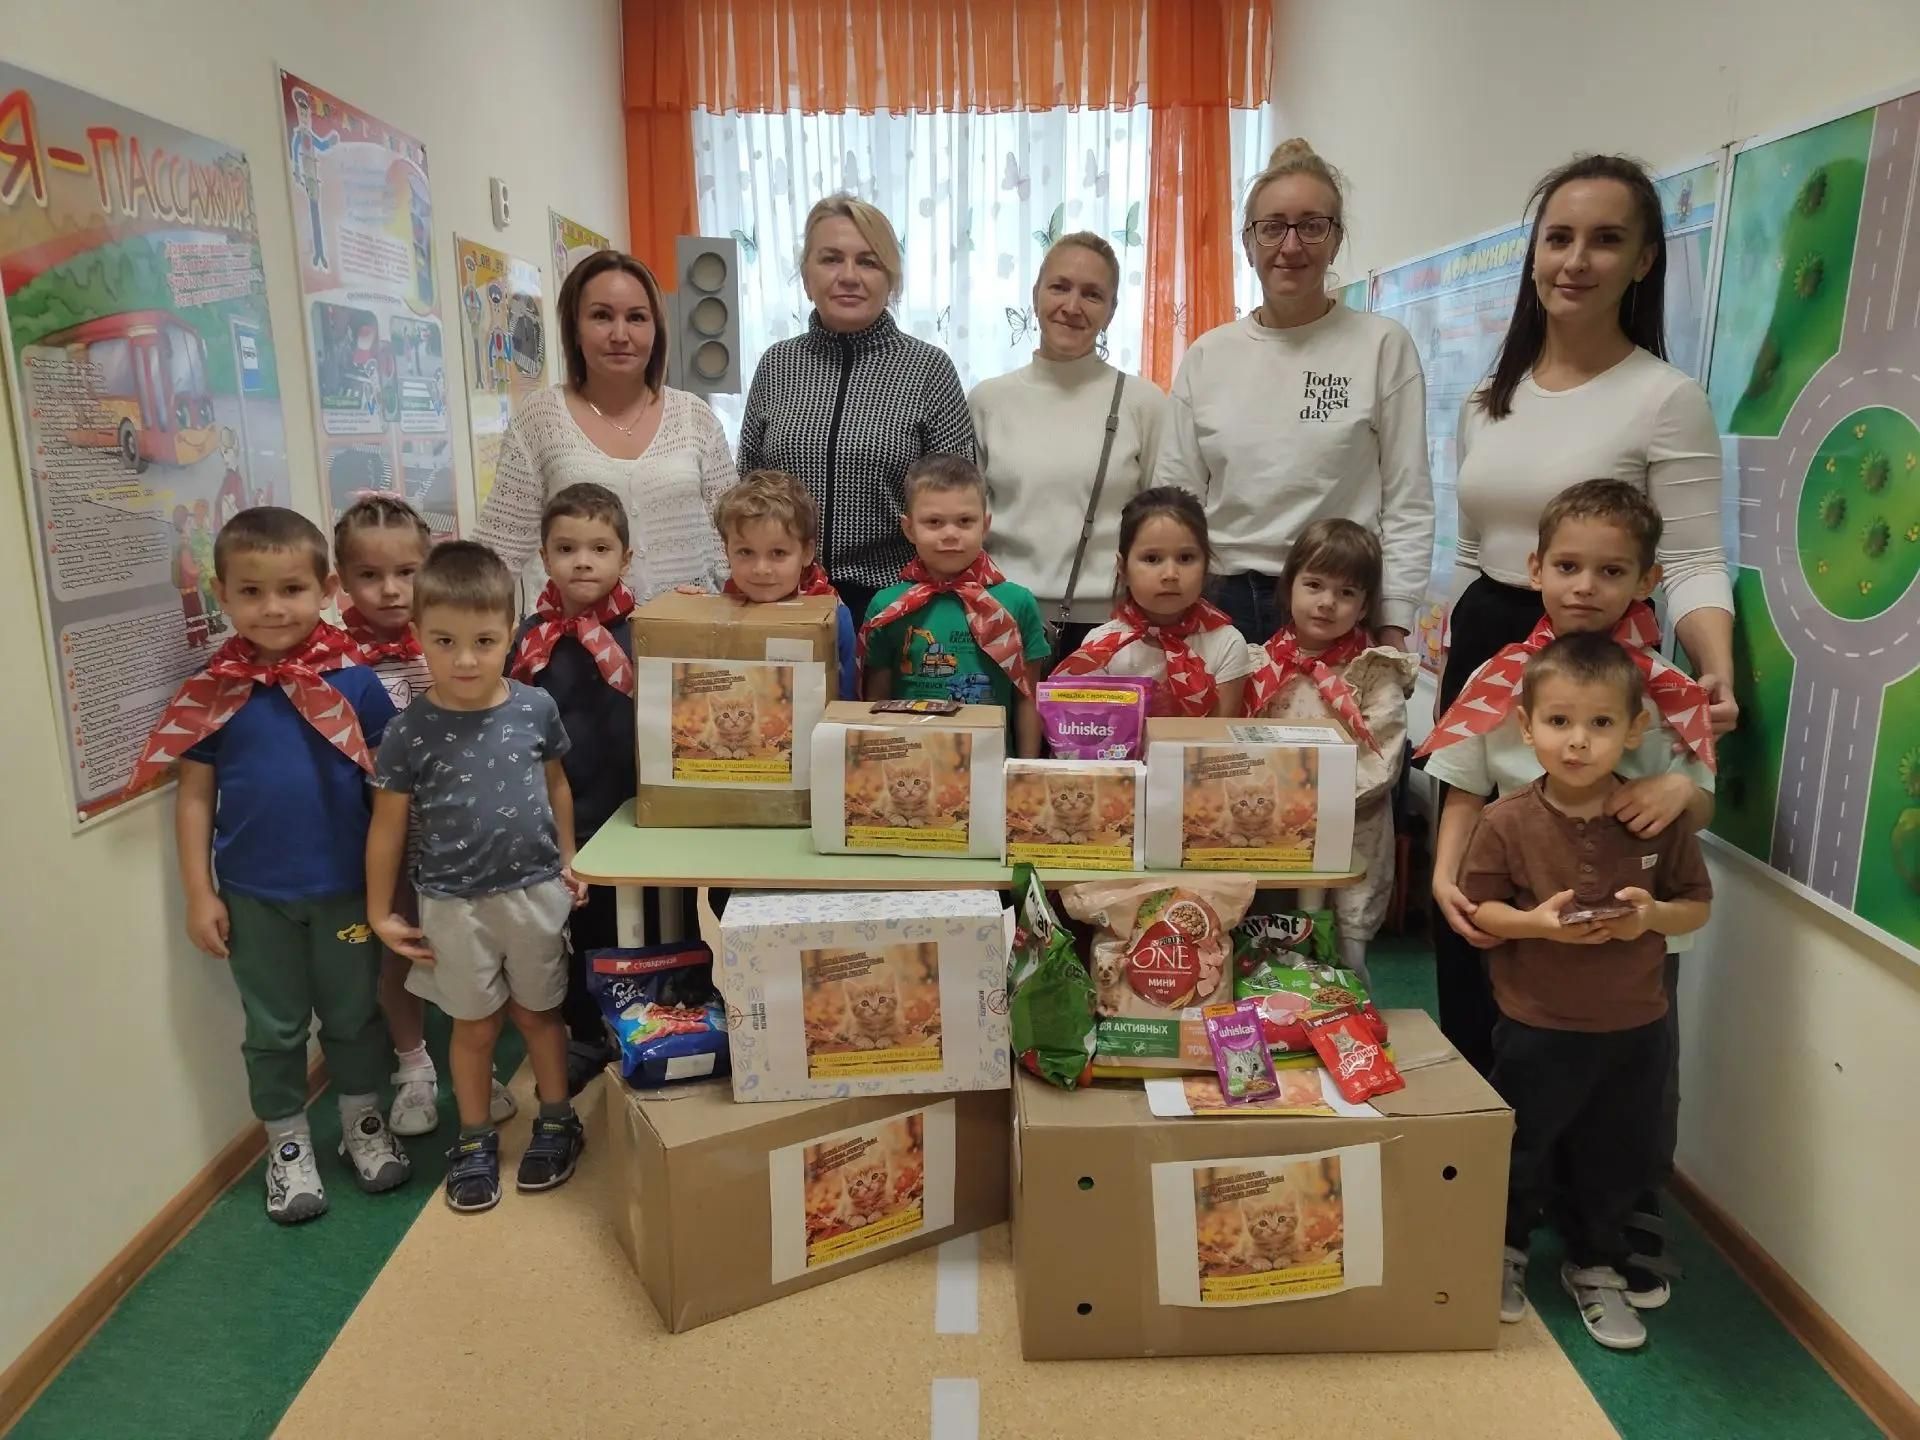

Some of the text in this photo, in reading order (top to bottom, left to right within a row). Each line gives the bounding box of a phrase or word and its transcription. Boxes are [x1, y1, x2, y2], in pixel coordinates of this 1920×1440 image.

[1302, 371, 1352, 387] Today
[1304, 384, 1348, 399] is the
[1317, 397, 1349, 410] best
[1300, 406, 1331, 422] day
[1058, 722, 1115, 737] whiskas
[1133, 945, 1192, 969] ONE
[1148, 978, 1176, 988] МИНИ
[1114, 1022, 1168, 1034] АКТИВНЫХ
[1219, 1024, 1256, 1037] whiskas
[1339, 1045, 1378, 1075] ДАРЛИНГ
